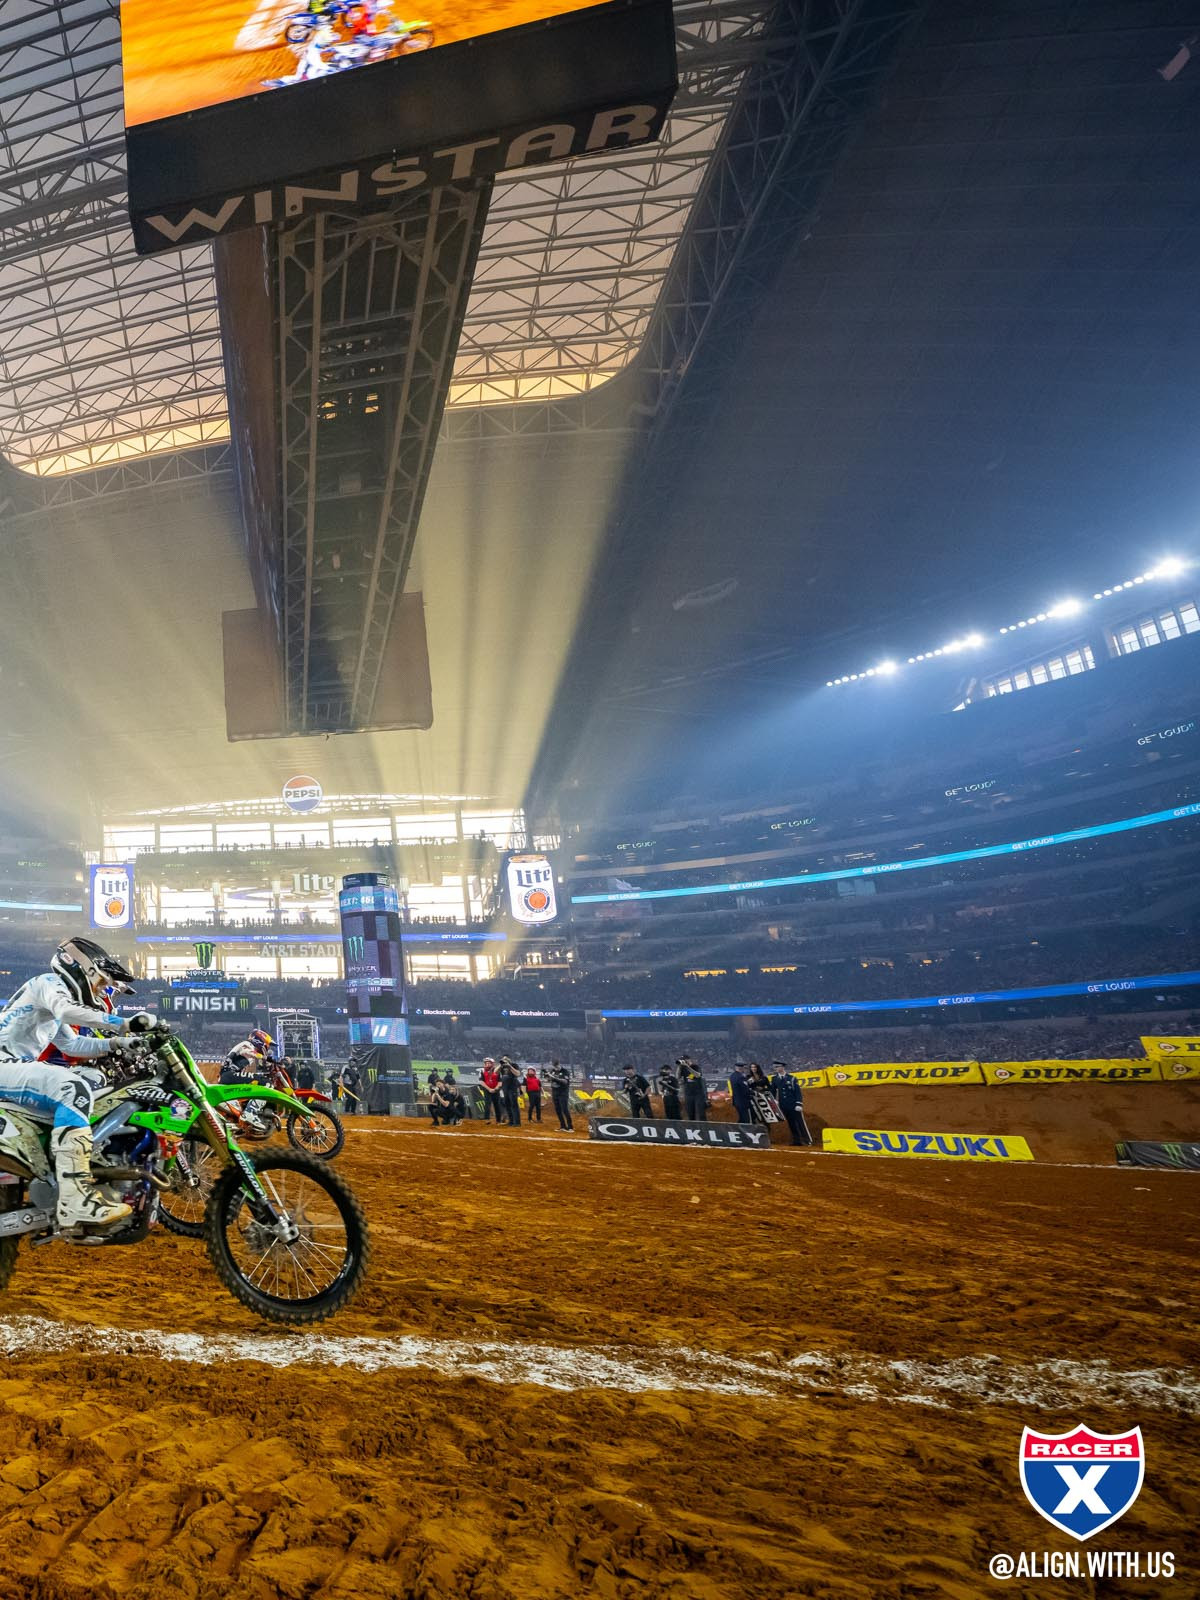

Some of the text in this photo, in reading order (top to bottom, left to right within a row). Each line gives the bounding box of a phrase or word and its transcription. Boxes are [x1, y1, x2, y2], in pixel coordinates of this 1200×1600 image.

[145, 105, 657, 242] WINSTAR
[1137, 733, 1158, 746] GET
[285, 789, 320, 799] PEPSI
[1173, 807, 1189, 817] GET
[1012, 841, 1028, 850] GET
[291, 873, 335, 895] Lite
[515, 868, 551, 888] Lite
[101, 878, 128, 896] Lite
[260, 944, 296, 958] AT&T
[1087, 984, 1104, 992] GET
[174, 996, 236, 1012] FINISH
[856, 1066, 970, 1082] DUNLOP
[1020, 1068, 1152, 1080] DUNLOP
[642, 1126, 762, 1144] OAKLEY
[854, 1131, 1010, 1158] SUZUKI
[234, 1153, 266, 1200] DUNLOP
